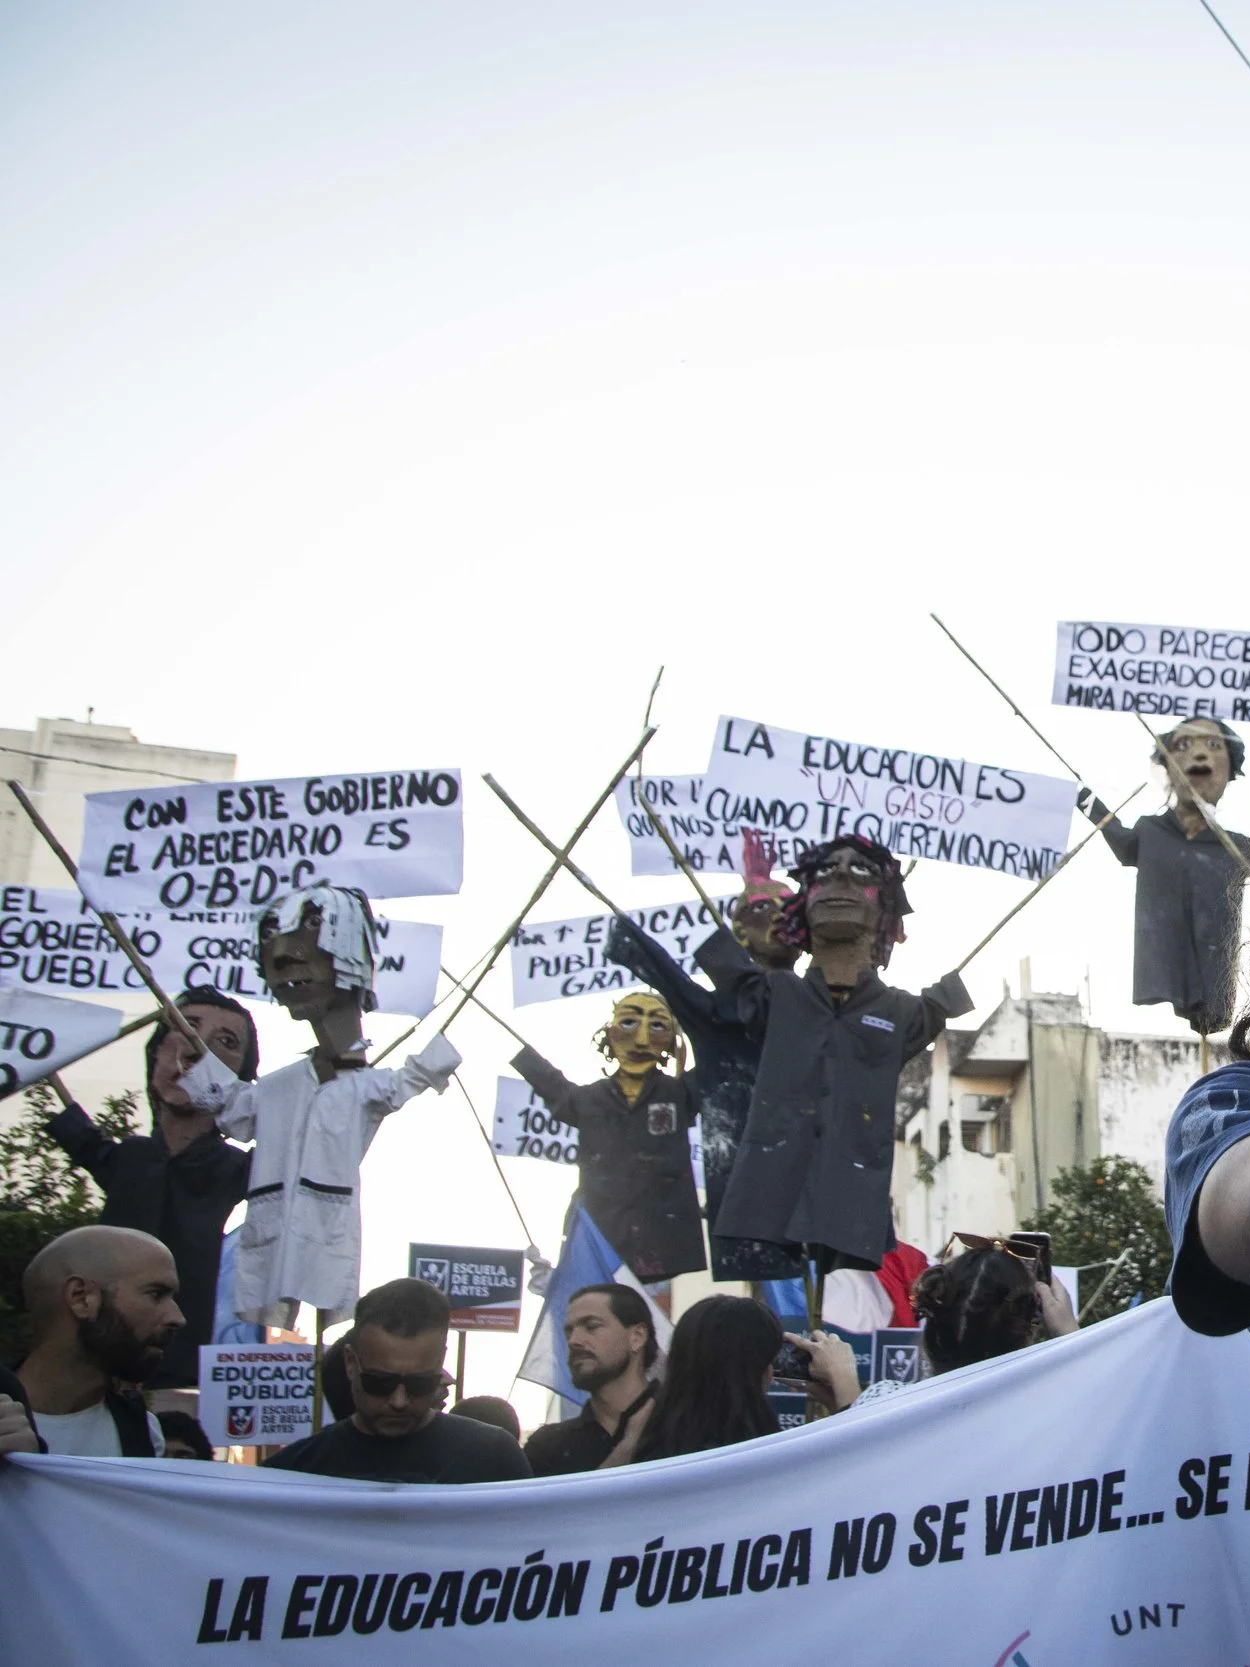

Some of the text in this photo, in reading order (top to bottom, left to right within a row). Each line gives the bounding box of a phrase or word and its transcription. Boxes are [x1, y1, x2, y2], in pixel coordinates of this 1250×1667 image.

[1066, 621, 1146, 654] TODO
[1069, 654, 1215, 688] EXAGERADO
[1066, 683, 1115, 711] MIRA
[1122, 690, 1188, 717] DESDE
[1194, 697, 1225, 718] EL
[723, 720, 1025, 803] LA EDUCACION ES
[124, 771, 459, 831] CON ESTE GOBIERNO
[706, 787, 808, 832] CUANDO
[817, 801, 851, 838] TE
[628, 813, 661, 838] QU
[105, 818, 410, 877] EL ABECEDARIO ES
[718, 843, 735, 871] A
[1, 887, 47, 913] EL
[188, 936, 260, 961] CORR
[184, 962, 271, 995] CUL
[451, 1274, 517, 1288] DE BELLAS
[452, 1263, 507, 1276] ESCUELA
[450, 1286, 490, 1297] ARTES
[216, 1352, 234, 1362] EN
[238, 1352, 294, 1362] DEFENSA
[262, 1405, 309, 1414] ESCUELA
[281, 1415, 312, 1424] BELLA
[261, 1424, 294, 1434] ARTES
[197, 1576, 269, 1643] LA
[281, 1550, 591, 1640] EDUCACIÓN
[600, 1536, 812, 1613] PÚBLICA
[827, 1512, 897, 1581] NO
[908, 1499, 970, 1567] SE
[985, 1469, 1164, 1556] VENDE...
[1175, 1454, 1232, 1520] SE
[1110, 1603, 1185, 1636] UNT
